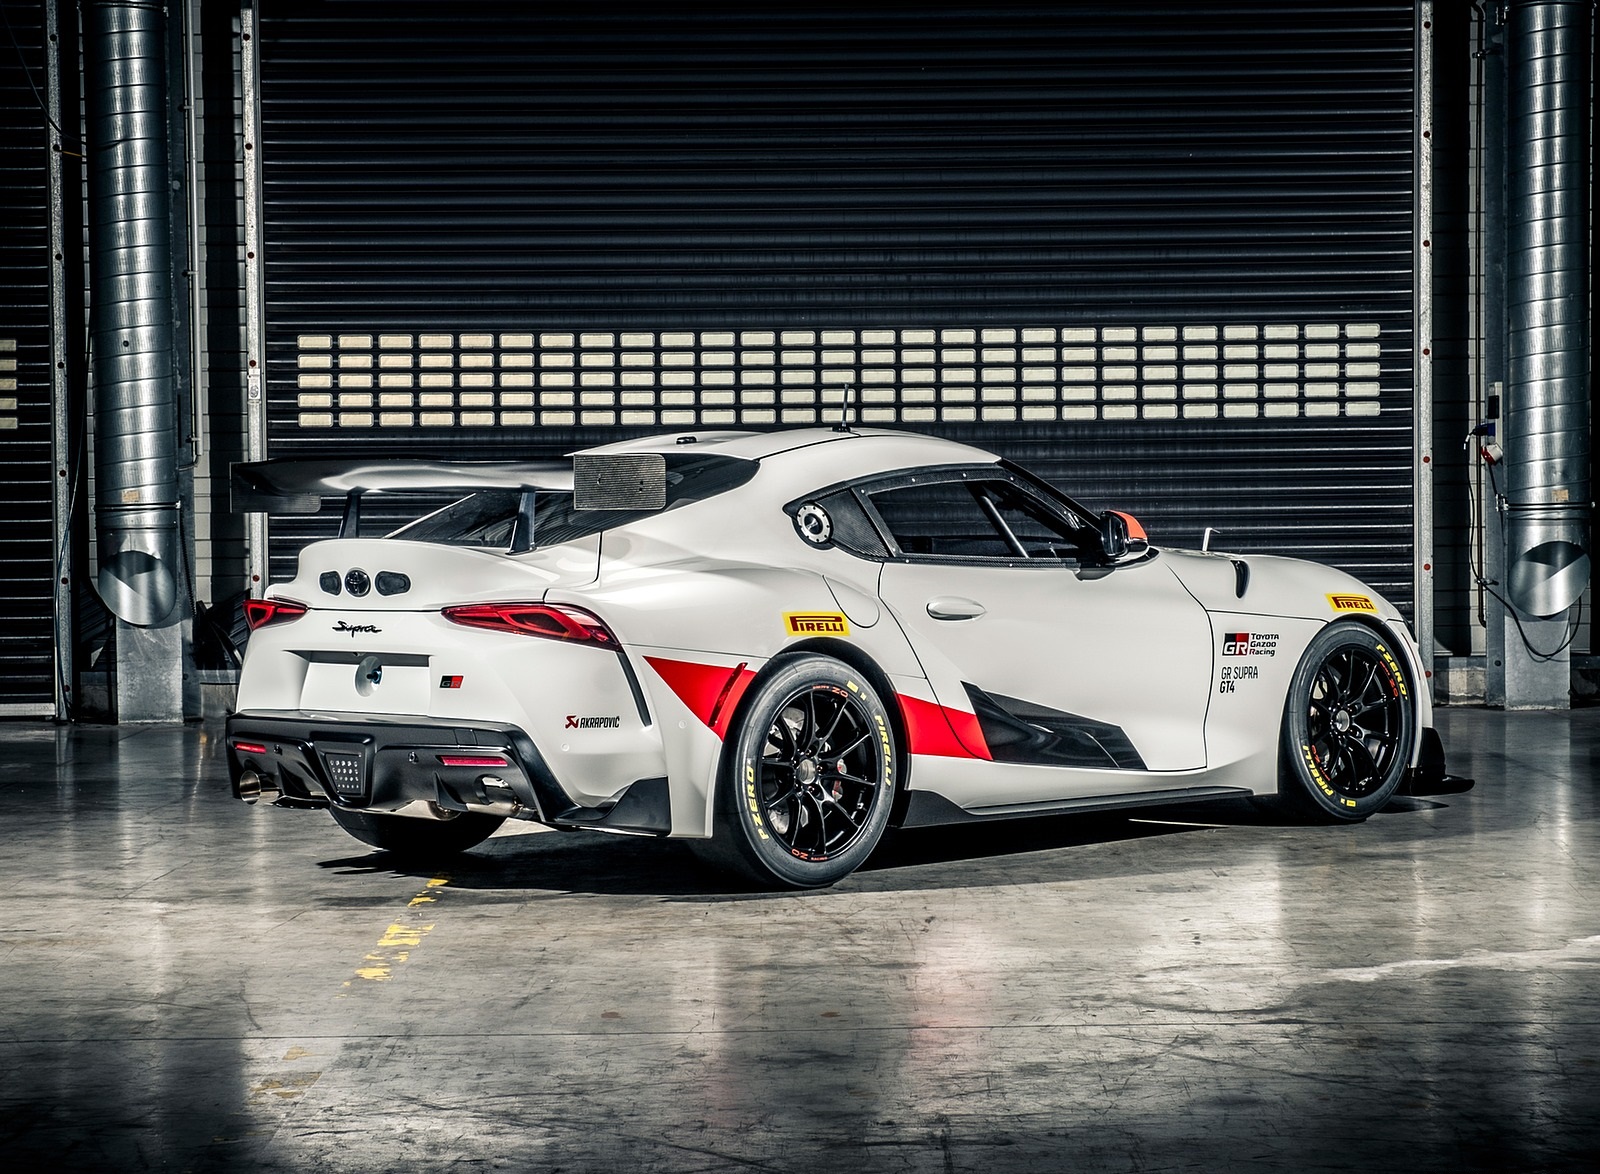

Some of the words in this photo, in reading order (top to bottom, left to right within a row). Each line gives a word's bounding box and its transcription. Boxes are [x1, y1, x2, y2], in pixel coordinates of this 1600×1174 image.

[1332, 597, 1374, 609] PIRELLI
[332, 621, 382, 638] Supra
[789, 616, 844, 631] PIRELLI
[1223, 641, 1248, 655] GR
[1250, 648, 1275, 657] Racing
[1221, 667, 1231, 679] GR
[1233, 666, 1258, 679] SUPRA
[1220, 681, 1234, 693] GT4
[874, 715, 891, 786] PIRELLI
[1302, 745, 1333, 795] PIRELLI
